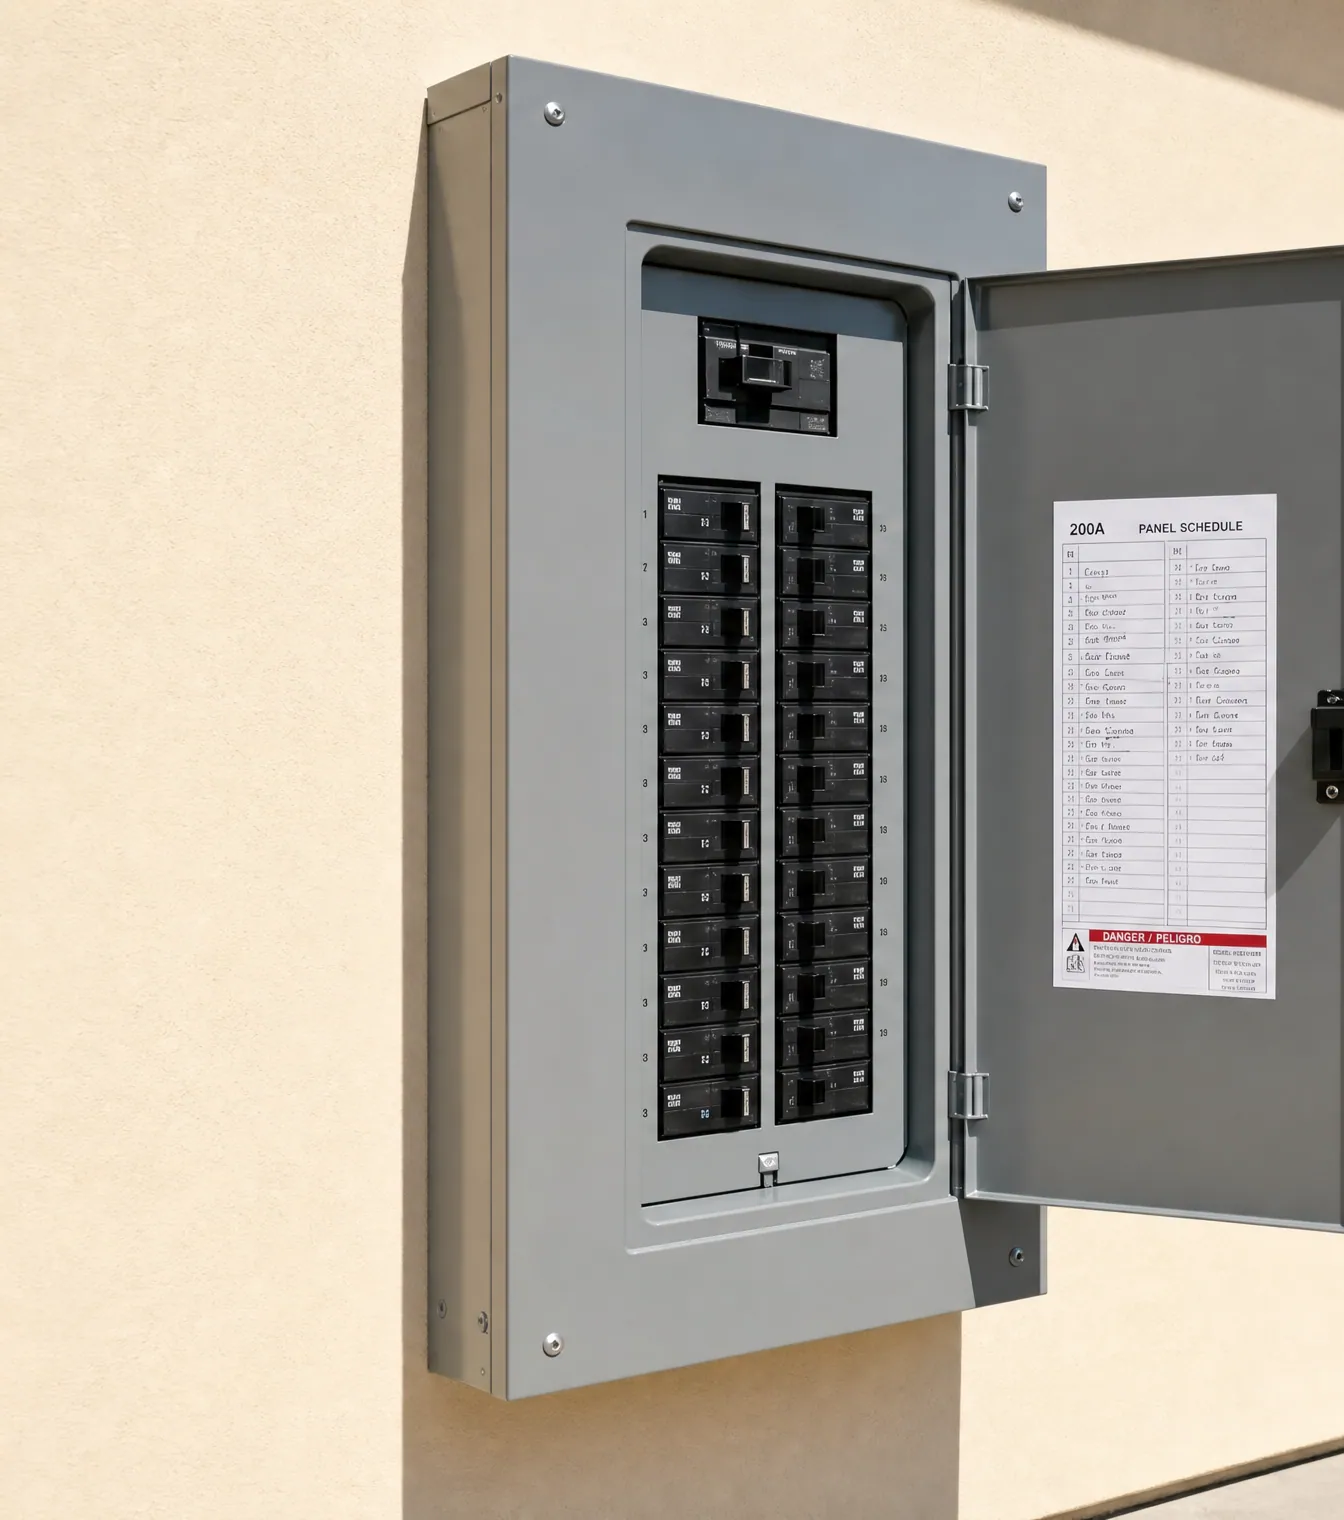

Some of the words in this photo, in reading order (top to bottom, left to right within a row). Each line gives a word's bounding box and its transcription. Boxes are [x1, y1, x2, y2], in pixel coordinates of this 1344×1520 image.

[1070, 522, 1105, 536] 200A
[1139, 523, 1176, 534] PANEL
[1180, 521, 1243, 533] SCHEDULE
[1103, 931, 1145, 943] DANGER
[1156, 933, 1202, 944] PELIGRO
